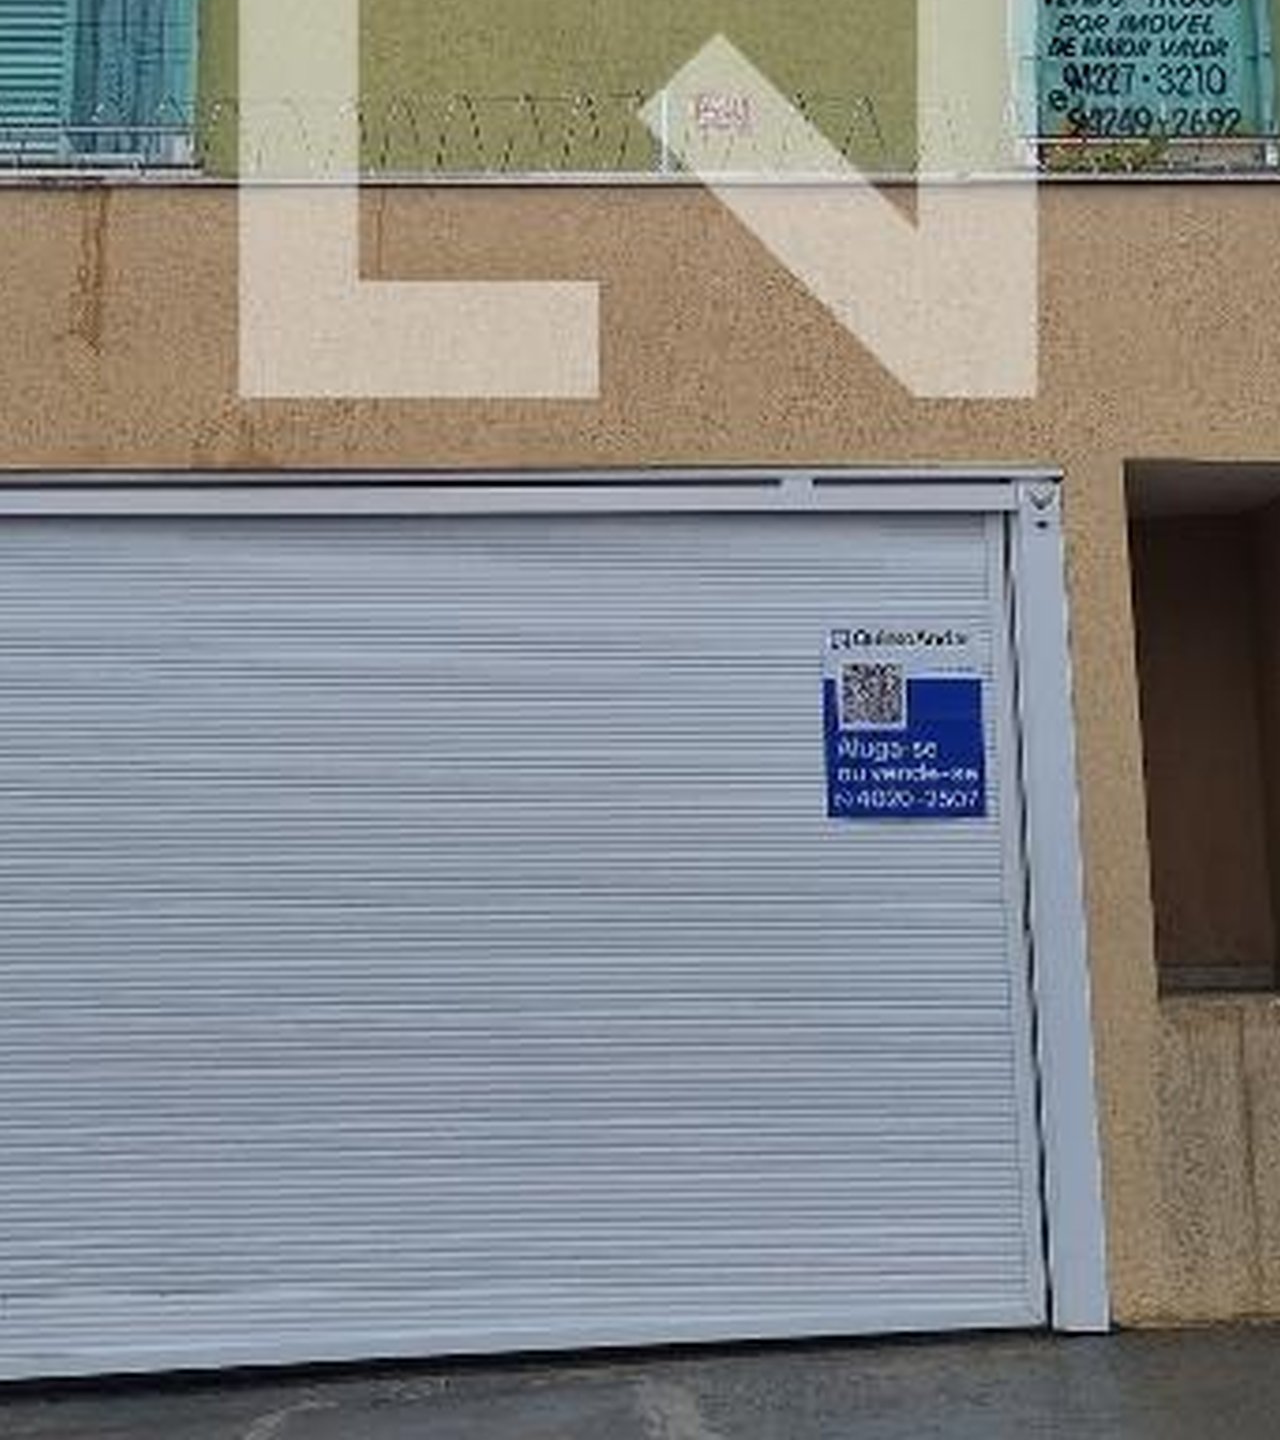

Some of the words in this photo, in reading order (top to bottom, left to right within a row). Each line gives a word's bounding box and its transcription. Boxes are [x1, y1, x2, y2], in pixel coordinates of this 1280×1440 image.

[1056, 14, 1110, 35] POR
[1048, 36, 1077, 57] DE
[1160, 37, 1230, 59] VALOR
